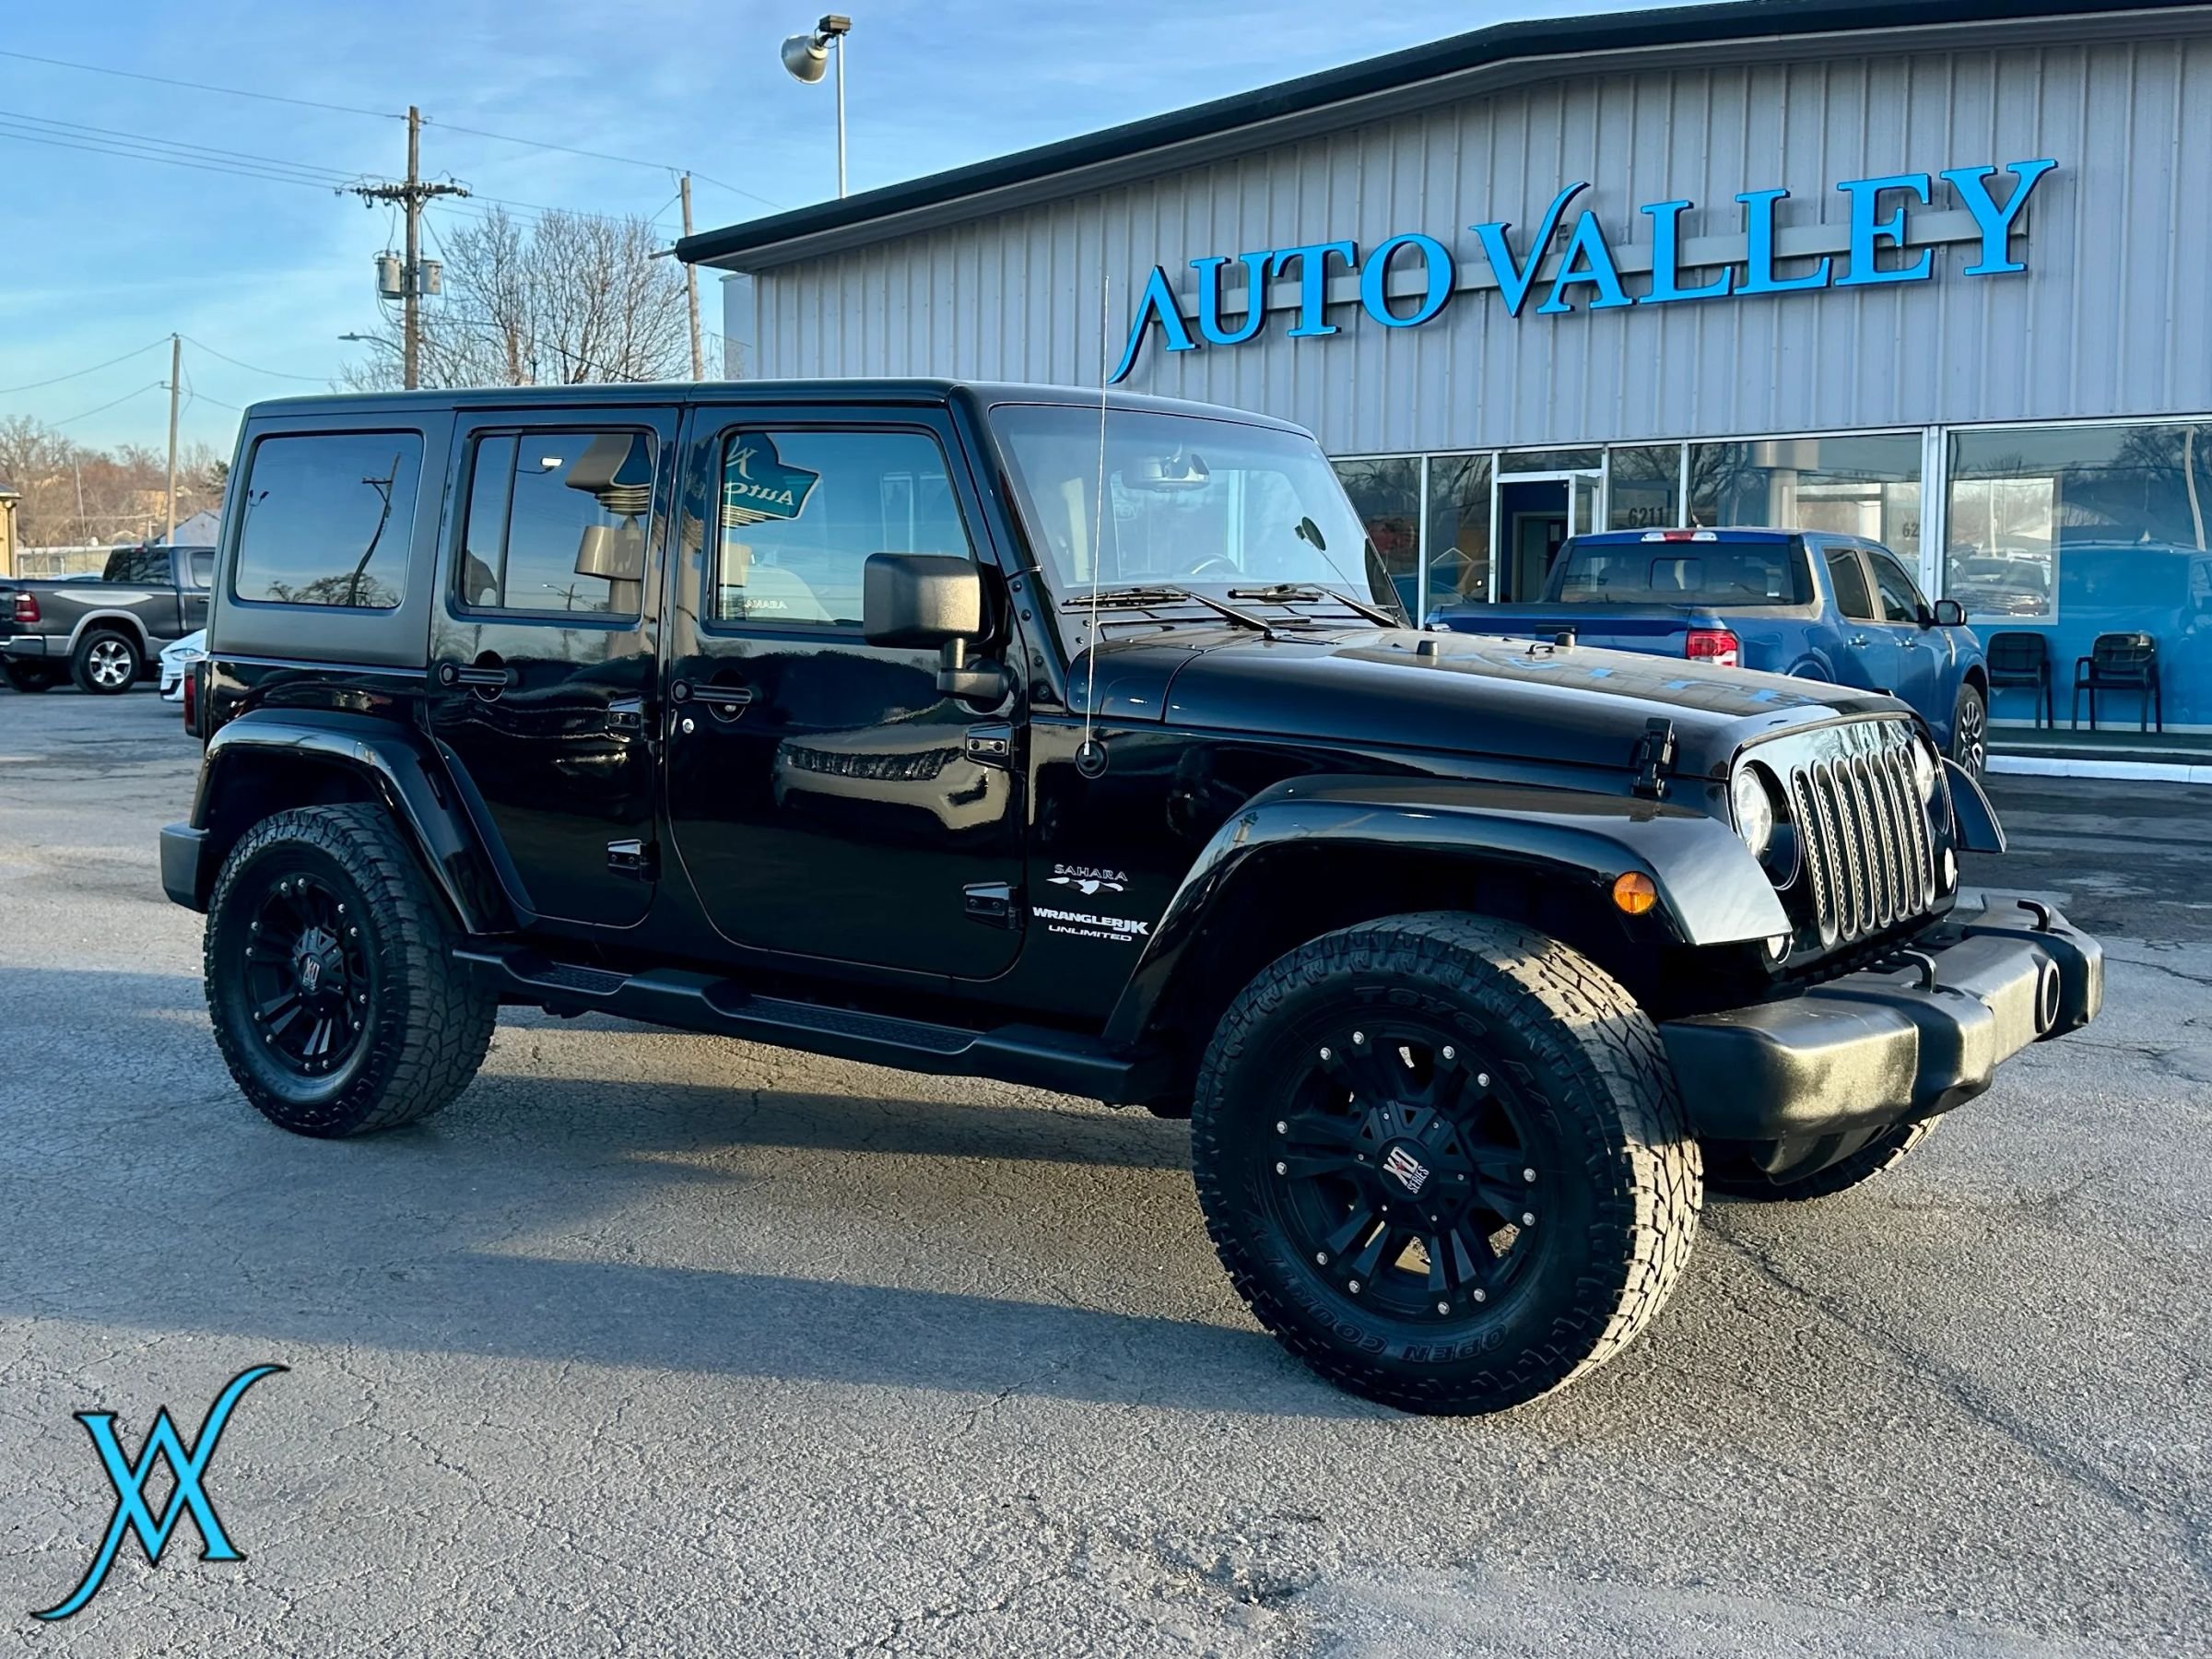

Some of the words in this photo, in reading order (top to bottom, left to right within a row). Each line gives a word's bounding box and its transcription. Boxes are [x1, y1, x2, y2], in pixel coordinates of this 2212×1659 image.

[1107, 233, 1456, 384] AUTO
[1470, 158, 2059, 319] VALLEY
[1628, 506, 1665, 527] 6211
[1053, 864, 1129, 882] SAHARA
[1048, 924, 1133, 942] UNLIMITED
[1352, 985, 1488, 1038] TOYO
[1382, 1147, 1419, 1187] XD
[1406, 1165, 1430, 1194] SERIES
[1398, 1322, 1509, 1364] OPEN
